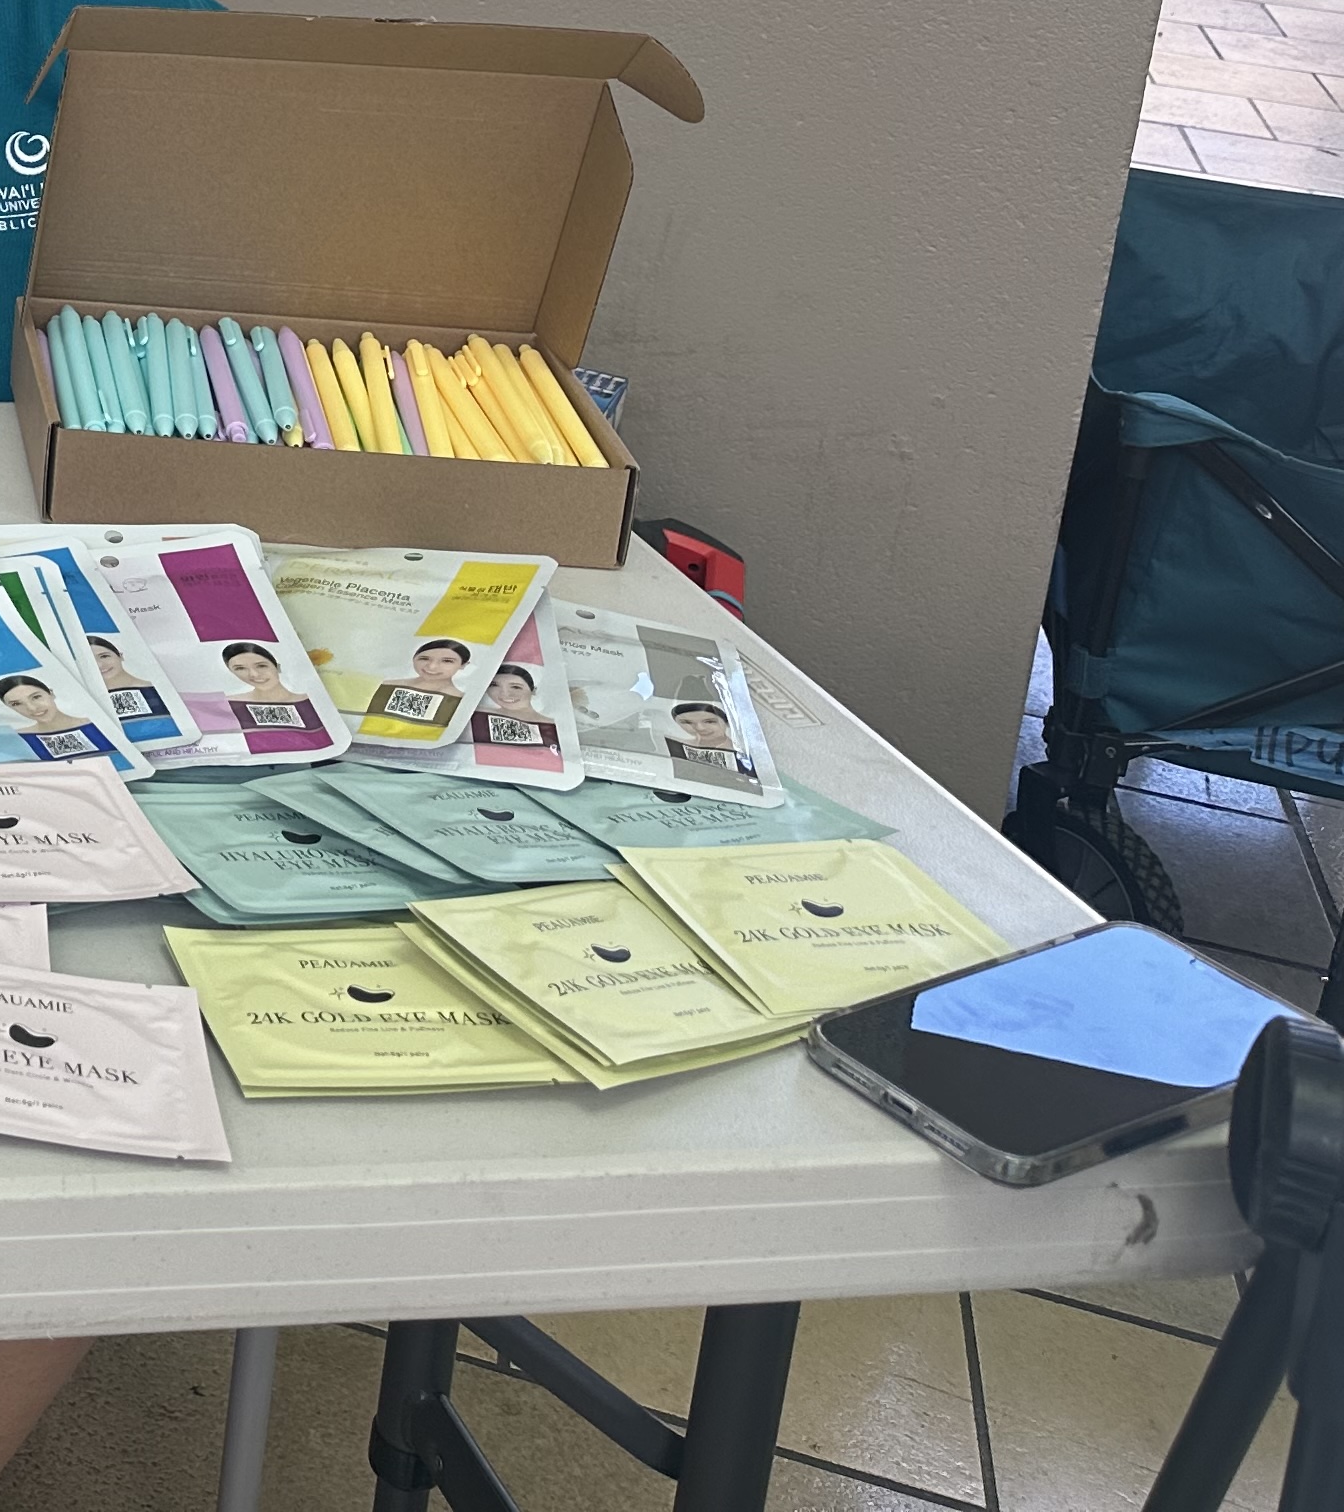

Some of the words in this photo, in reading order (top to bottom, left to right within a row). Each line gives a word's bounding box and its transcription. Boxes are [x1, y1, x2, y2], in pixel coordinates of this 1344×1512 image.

[280, 575, 342, 590] Vegetable
[346, 581, 410, 602] Placenta
[128, 603, 162, 614] Mask
[34, 832, 100, 846] MASK
[274, 859, 321, 870] EYE
[323, 857, 378, 869] MASK
[744, 873, 828, 884] PEAUAMIE
[734, 929, 779, 943] 24K
[779, 926, 841, 939] GOLD
[840, 924, 887, 937] EYE
[886, 923, 952, 938] MASK
[298, 959, 396, 969] PEAUAMIE
[548, 979, 589, 996] 24K
[585, 971, 639, 988] GOLD
[247, 1011, 294, 1025] 24K
[301, 1010, 371, 1024] GOLD
[379, 1011, 431, 1023] EYE
[436, 1011, 513, 1026] MASK
[3, 1049, 54, 1071] EYE
[64, 1061, 141, 1086] MASK
